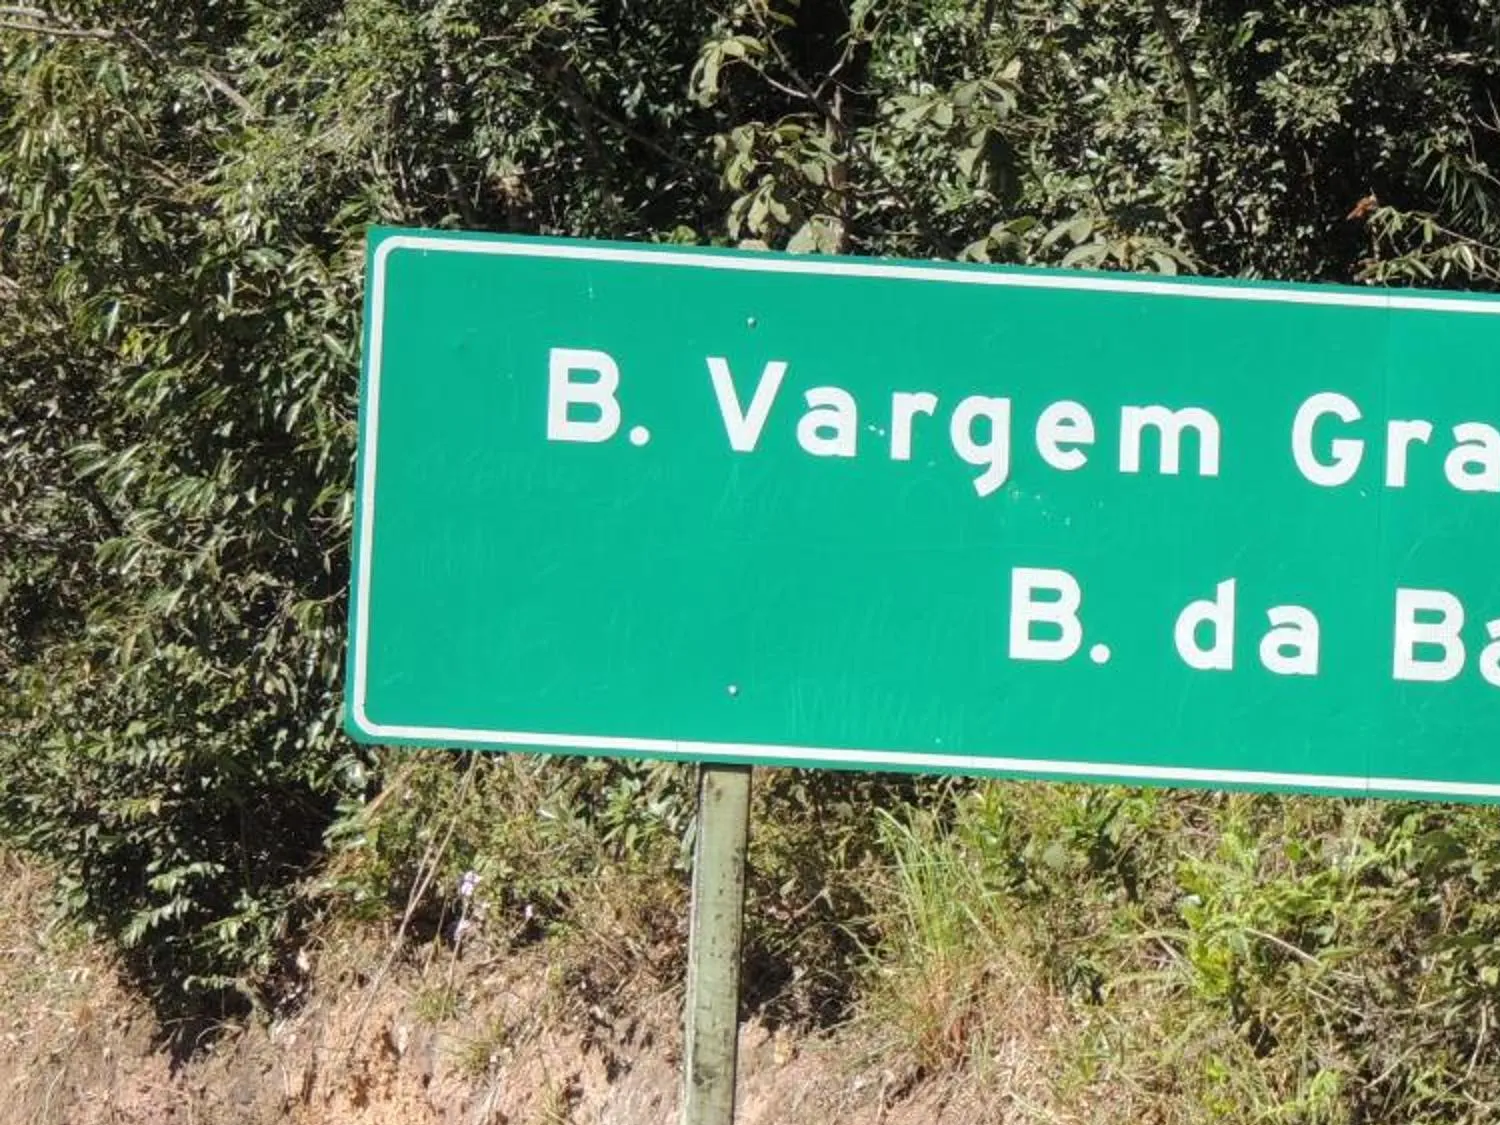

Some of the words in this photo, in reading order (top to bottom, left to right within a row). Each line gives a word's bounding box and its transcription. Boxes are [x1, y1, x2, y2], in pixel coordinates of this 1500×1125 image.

[546, 347, 650, 446] B.
[706, 356, 1221, 498] Vargem
[1008, 566, 1111, 664] B.
[1174, 577, 1320, 676] da
